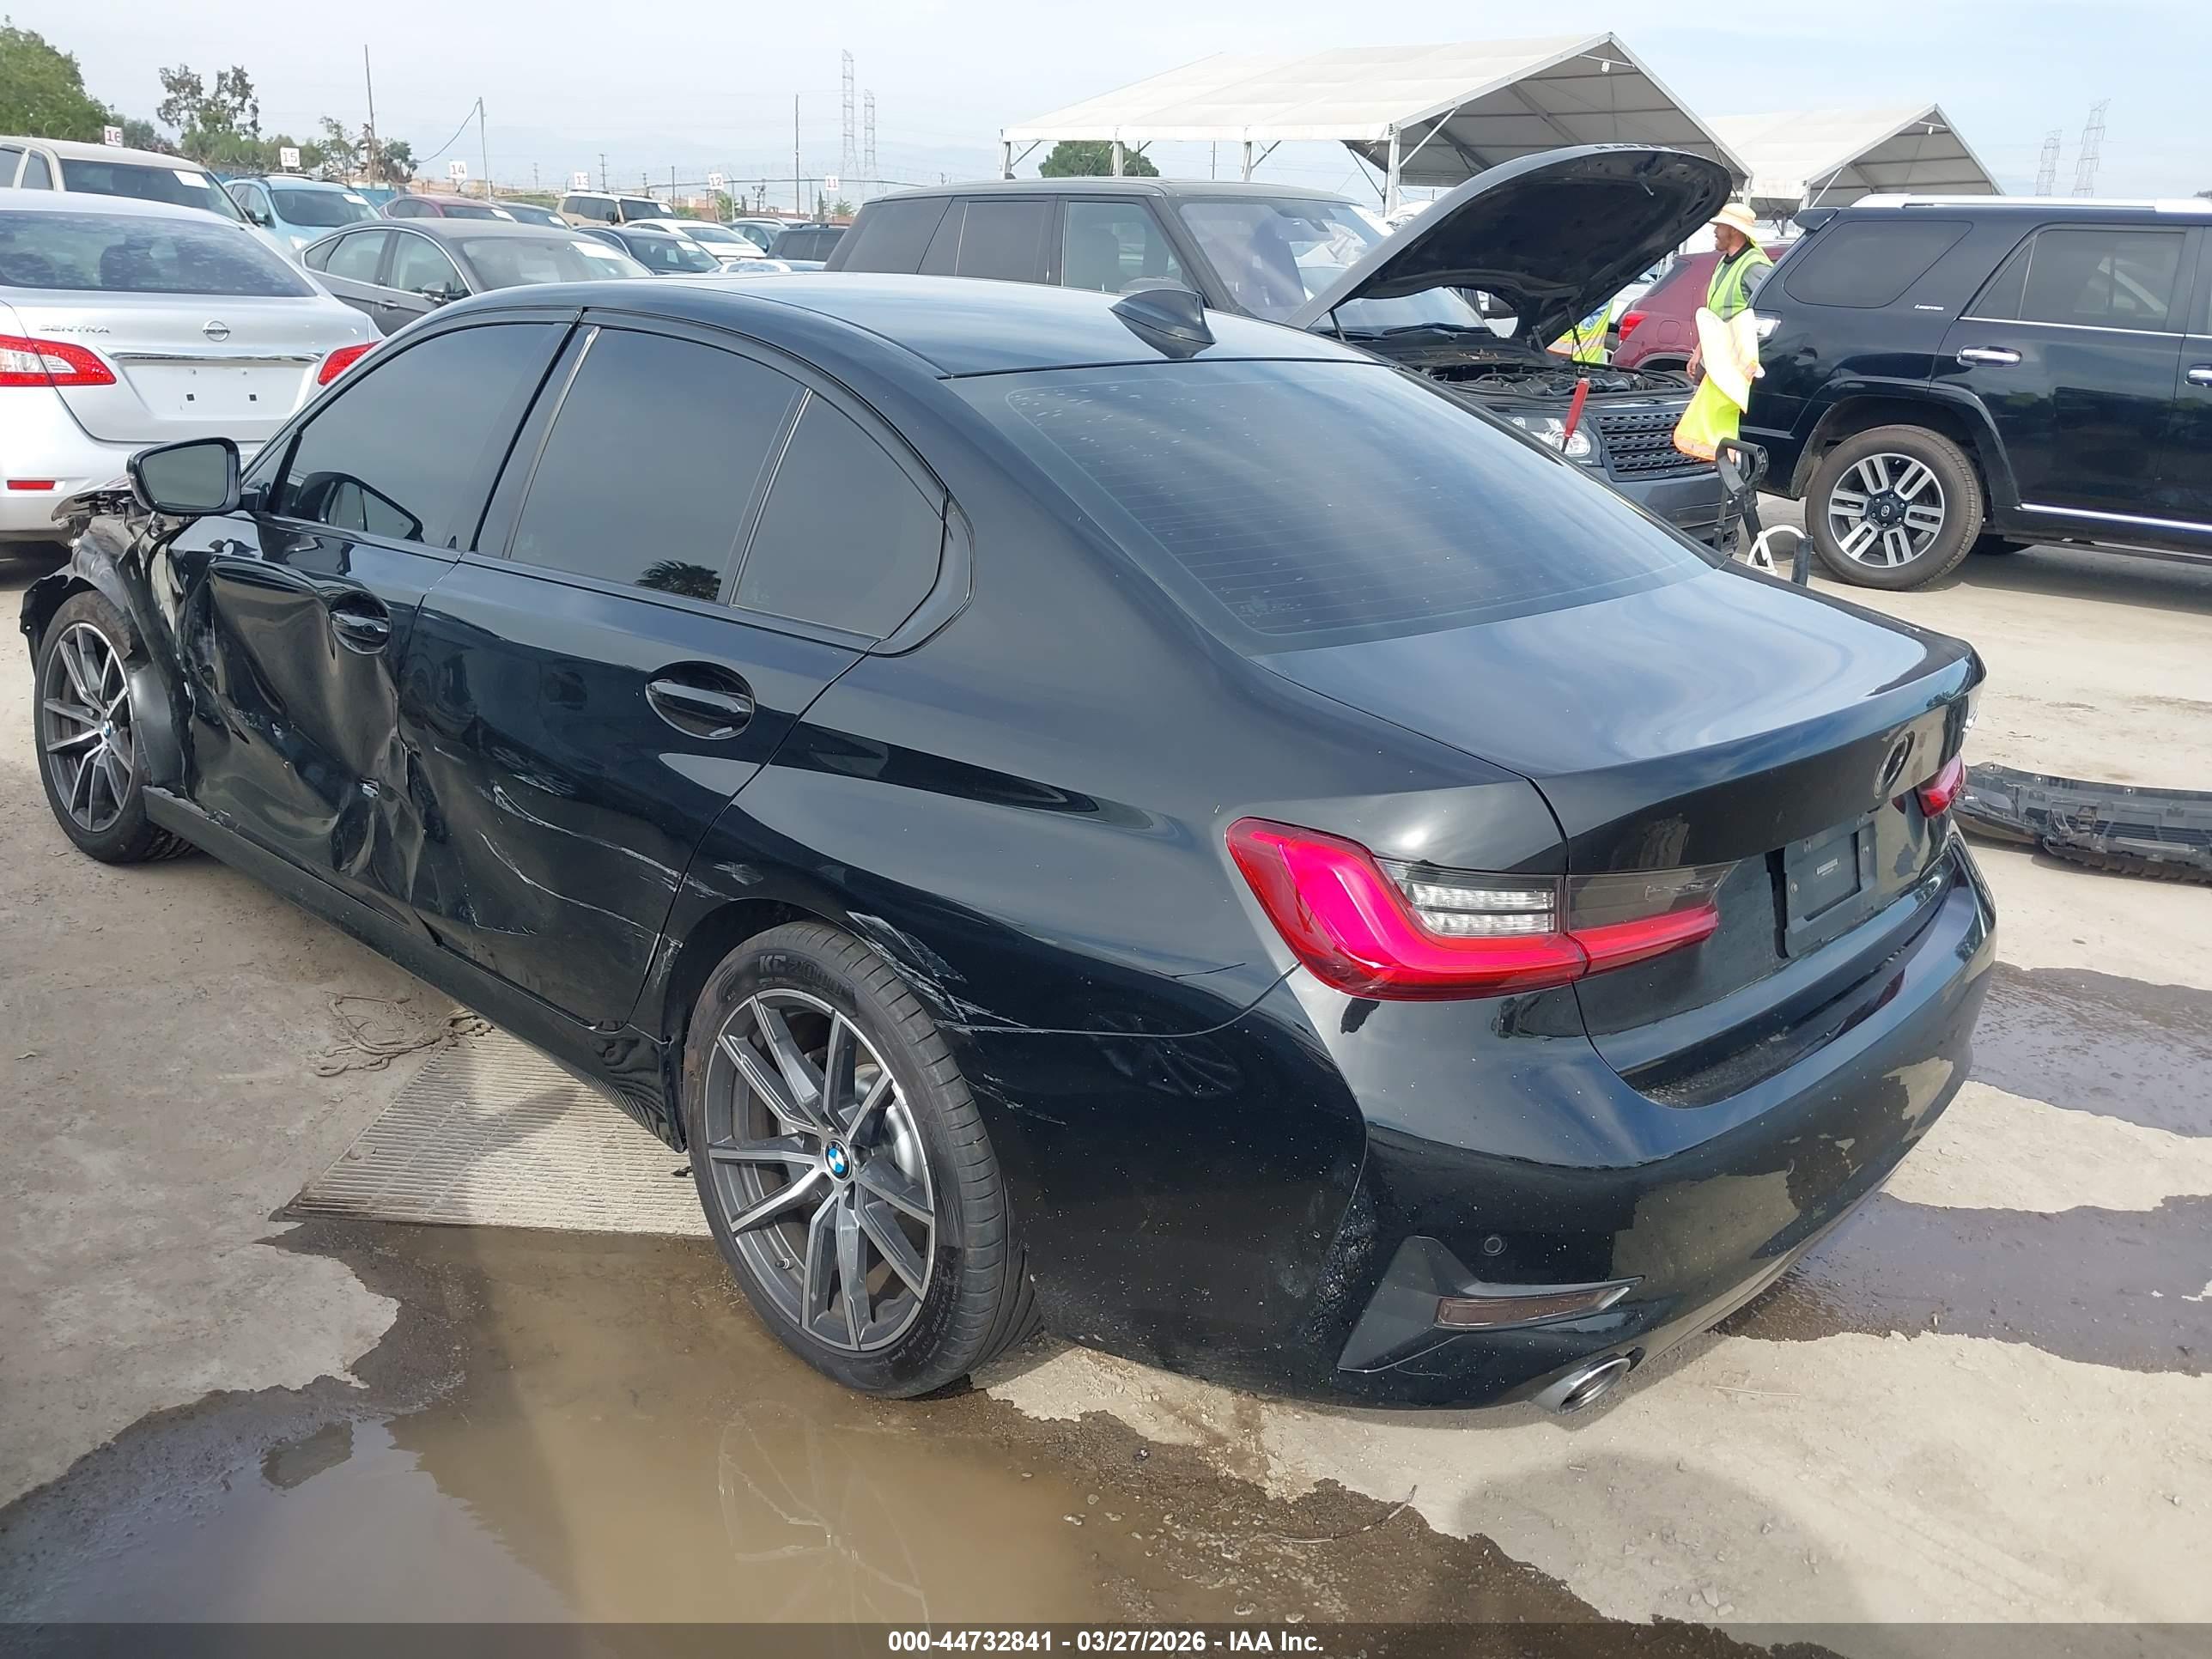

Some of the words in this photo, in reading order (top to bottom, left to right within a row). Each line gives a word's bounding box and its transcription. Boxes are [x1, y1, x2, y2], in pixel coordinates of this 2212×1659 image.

[282, 151, 298, 163] 15
[451, 164, 465, 175] 14
[709, 176, 722, 187] 12
[827, 178, 837, 188] 11
[39, 325, 110, 334] SENTRA
